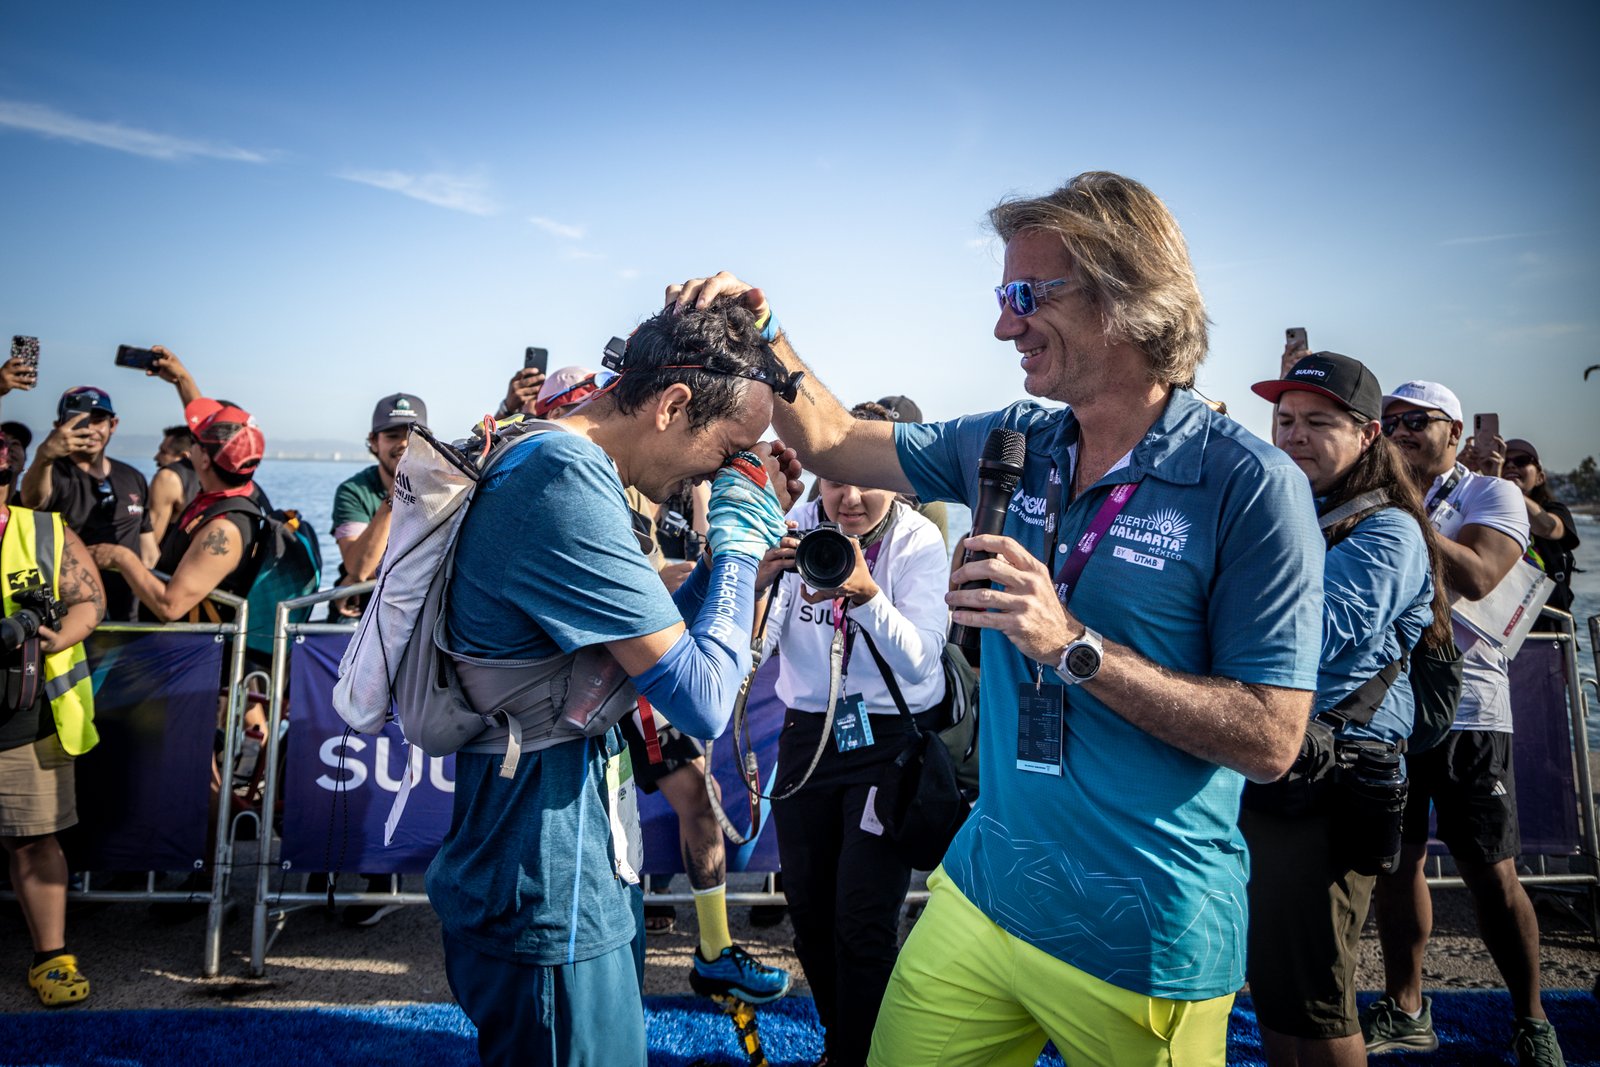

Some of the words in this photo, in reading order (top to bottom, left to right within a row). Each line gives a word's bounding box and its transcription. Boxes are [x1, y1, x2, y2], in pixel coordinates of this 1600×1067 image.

[1295, 369, 1325, 377] SUUNTO
[1008, 503, 1021, 513] FLY
[1114, 514, 1156, 531] PUERTO
[1109, 524, 1181, 552] VALLARTA
[1116, 547, 1126, 556] BY
[1134, 554, 1158, 567] UTMB
